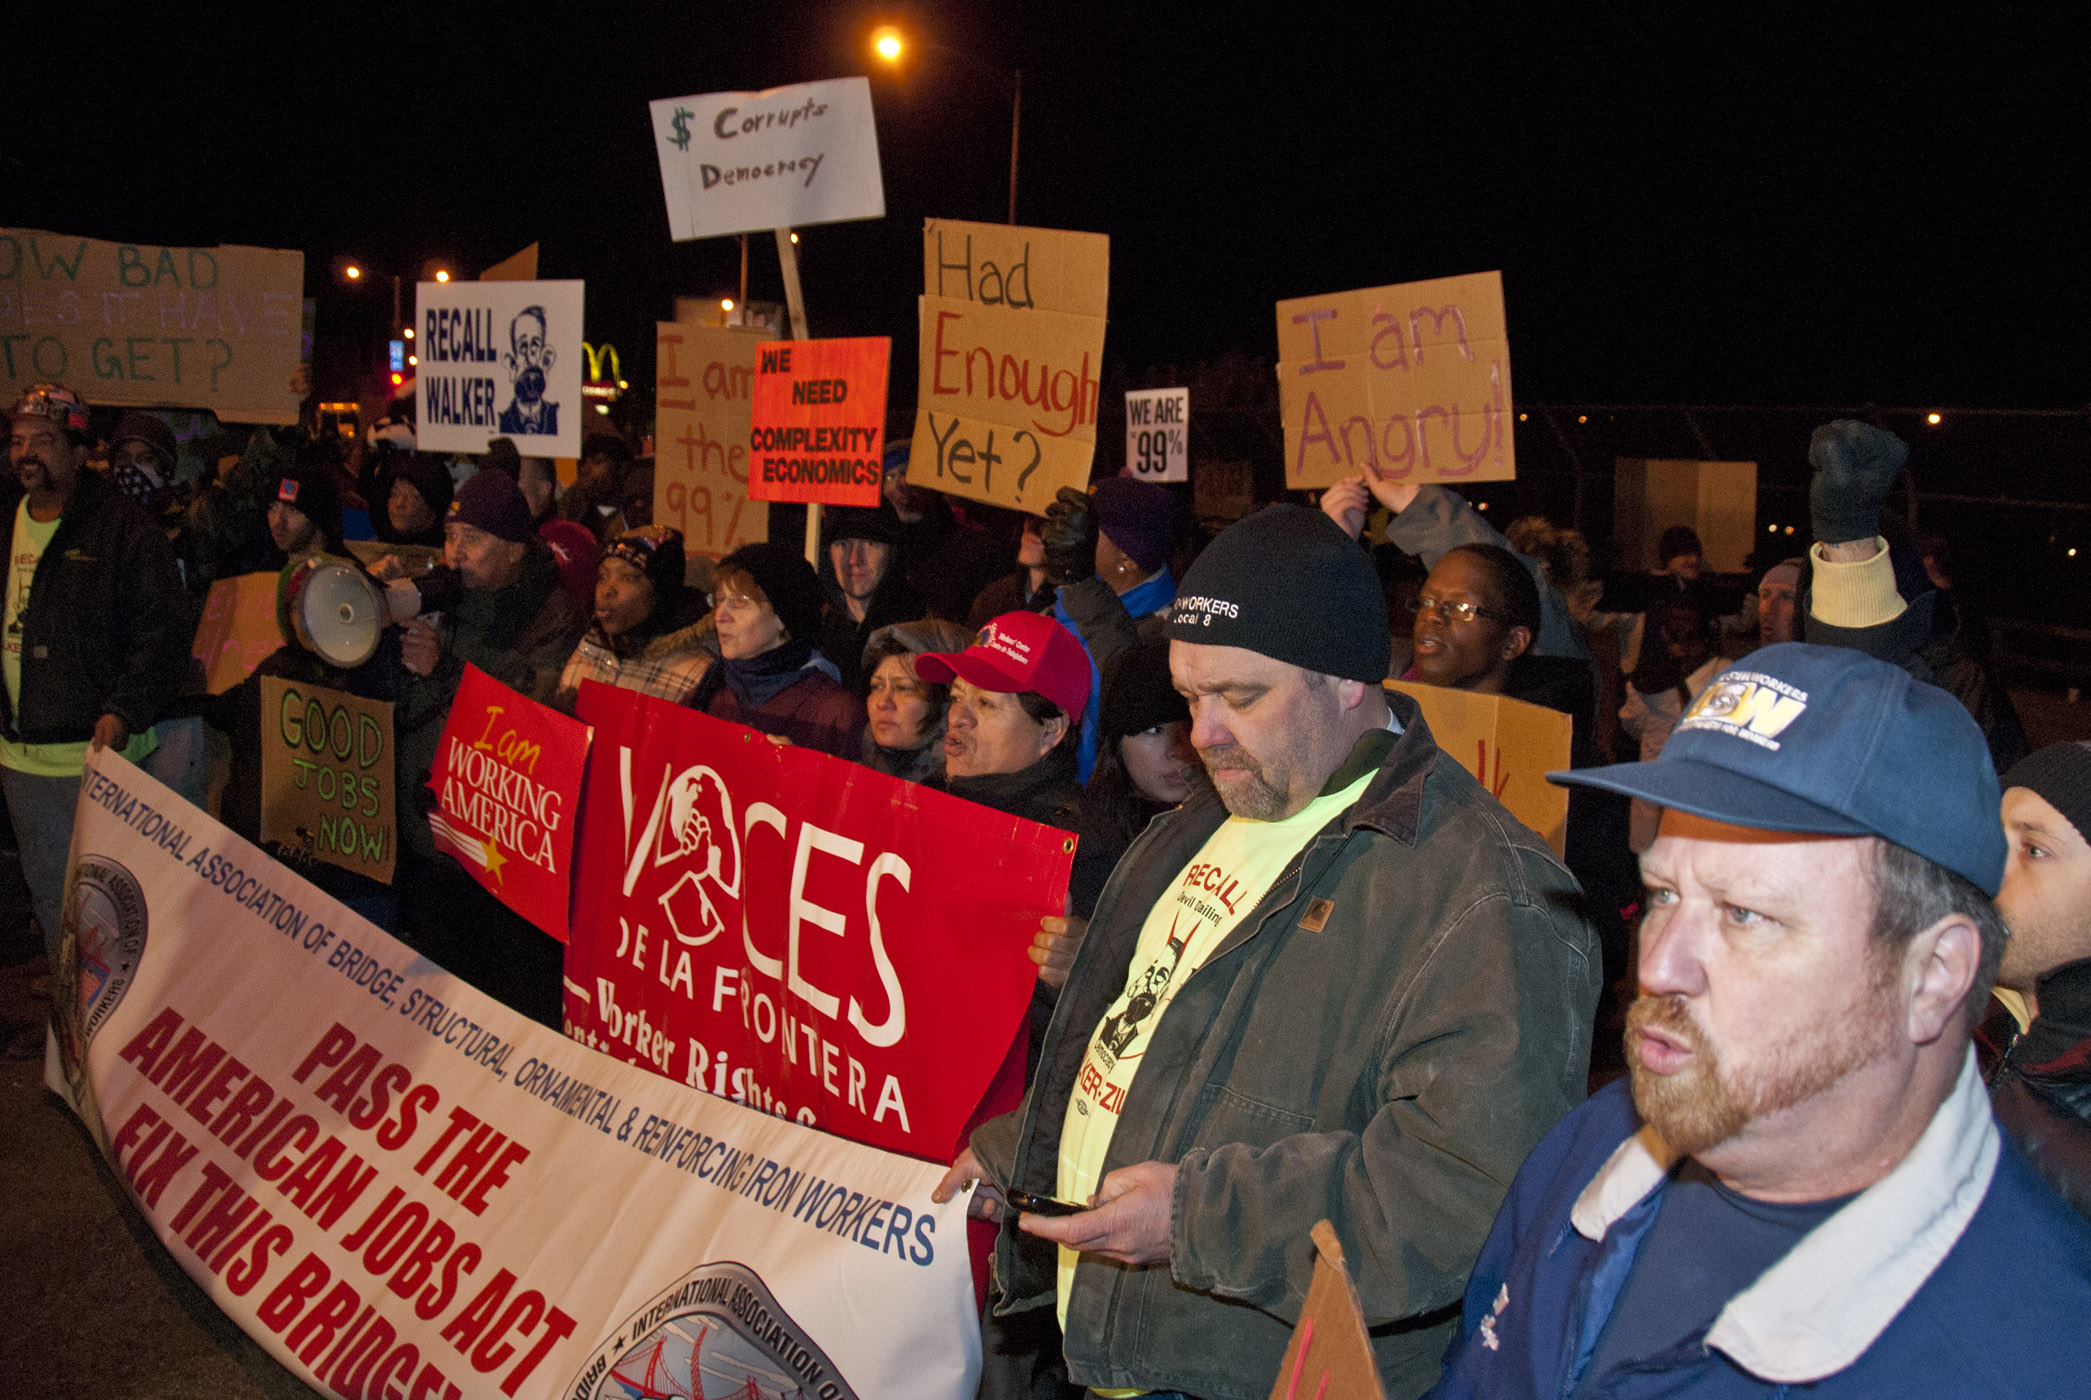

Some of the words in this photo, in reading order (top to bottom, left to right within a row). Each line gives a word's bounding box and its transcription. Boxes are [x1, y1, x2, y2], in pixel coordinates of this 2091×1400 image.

[666, 106, 695, 152] $
[713, 97, 829, 140] Corrupts
[700, 152, 825, 190] Democracy
[118, 243, 220, 290] BAD
[937, 231, 1034, 309] Had
[158, 291, 292, 337] HAVE
[425, 308, 497, 362] RECALL
[1292, 308, 1346, 374] I
[1370, 304, 1476, 370] am
[0, 335, 68, 380] TO
[92, 337, 233, 394] GET?
[658, 335, 690, 387] I
[761, 349, 792, 374] WE
[932, 310, 1099, 437] Enough
[425, 376, 497, 426] WALKER
[792, 379, 847, 405] NEED
[1129, 398, 1152, 425] WE
[1154, 396, 1184, 423] ARE
[1296, 360, 1505, 478] Angry!
[676, 421, 749, 485] the
[751, 426, 878, 453] COMPLEXITY
[927, 411, 1042, 504] Yet?
[1136, 428, 1184, 473] 99%
[763, 458, 880, 485] ECONOMICS
[1173, 612, 1199, 625] ocal
[1203, 613, 1212, 627] 8
[280, 687, 383, 770] GOOD
[473, 706, 505, 751] I
[497, 729, 541, 775] am
[293, 757, 379, 817] JOBS
[447, 735, 563, 831] WORKING
[440, 775, 557, 874] AMERICA
[1183, 863, 1248, 916] RECALL
[186, 847, 309, 940] ASSOCIATION
[302, 923, 337, 955] OF
[327, 940, 405, 1011] BRIDGE,
[400, 988, 515, 1083] STRUCTURAL,
[513, 1056, 622, 1136] ORNAMENTAL
[615, 1106, 640, 1142] &
[631, 1113, 757, 1193] REINFORCING
[740, 1156, 808, 1214] IRON
[792, 1174, 936, 1267] WORKERS
[658, 938, 694, 1000] LA
[712, 965, 912, 1134] FRONTERA
[291, 1021, 440, 1151] PASS
[412, 1104, 531, 1217] THE
[113, 1102, 200, 1210] FIX
[169, 1160, 295, 1297] THIS
[118, 1006, 379, 1232] AMERICAN
[339, 1185, 483, 1321] JOBS
[440, 1267, 578, 1398] ACT
[631, 1274, 733, 1342] INTERNATIONAL
[727, 1278, 824, 1385] ASSOCIATION
[571, 1353, 608, 1400] BRID
